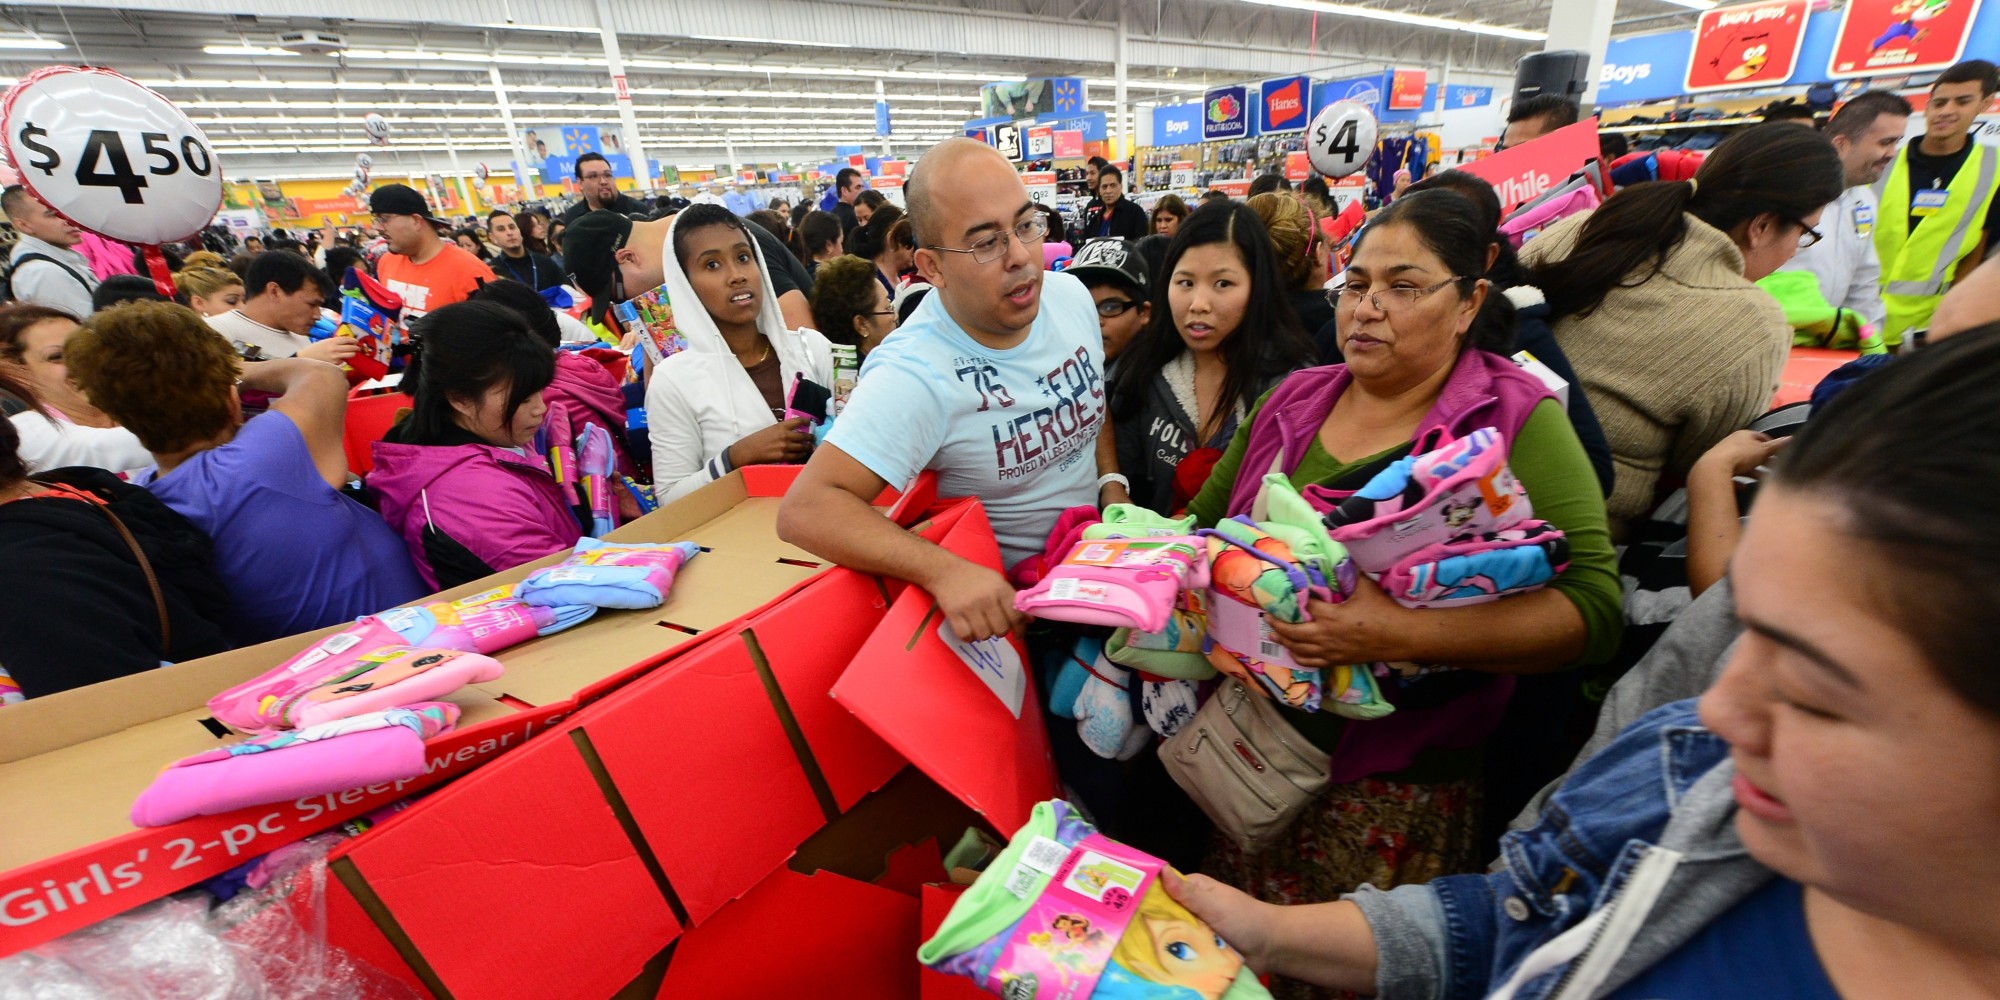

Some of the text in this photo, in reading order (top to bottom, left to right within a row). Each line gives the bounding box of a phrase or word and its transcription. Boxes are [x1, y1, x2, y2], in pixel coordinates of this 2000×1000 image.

[1599, 63, 1651, 85] Boys
[1270, 98, 1299, 111] Hanes
[1070, 119, 1092, 133] Baby
[1166, 120, 1189, 134] Boys
[1229, 187, 1243, 195] Price
[1493, 170, 1550, 209] While
[955, 365, 1016, 412] 76
[992, 383, 1105, 468] HEROES
[1149, 416, 1188, 454] HOLL
[999, 460, 1037, 480] PROVED
[1039, 453, 1048, 467] IN
[1047, 430, 1088, 461] LIBERATING
[162, 812, 285, 870] 2-pc
